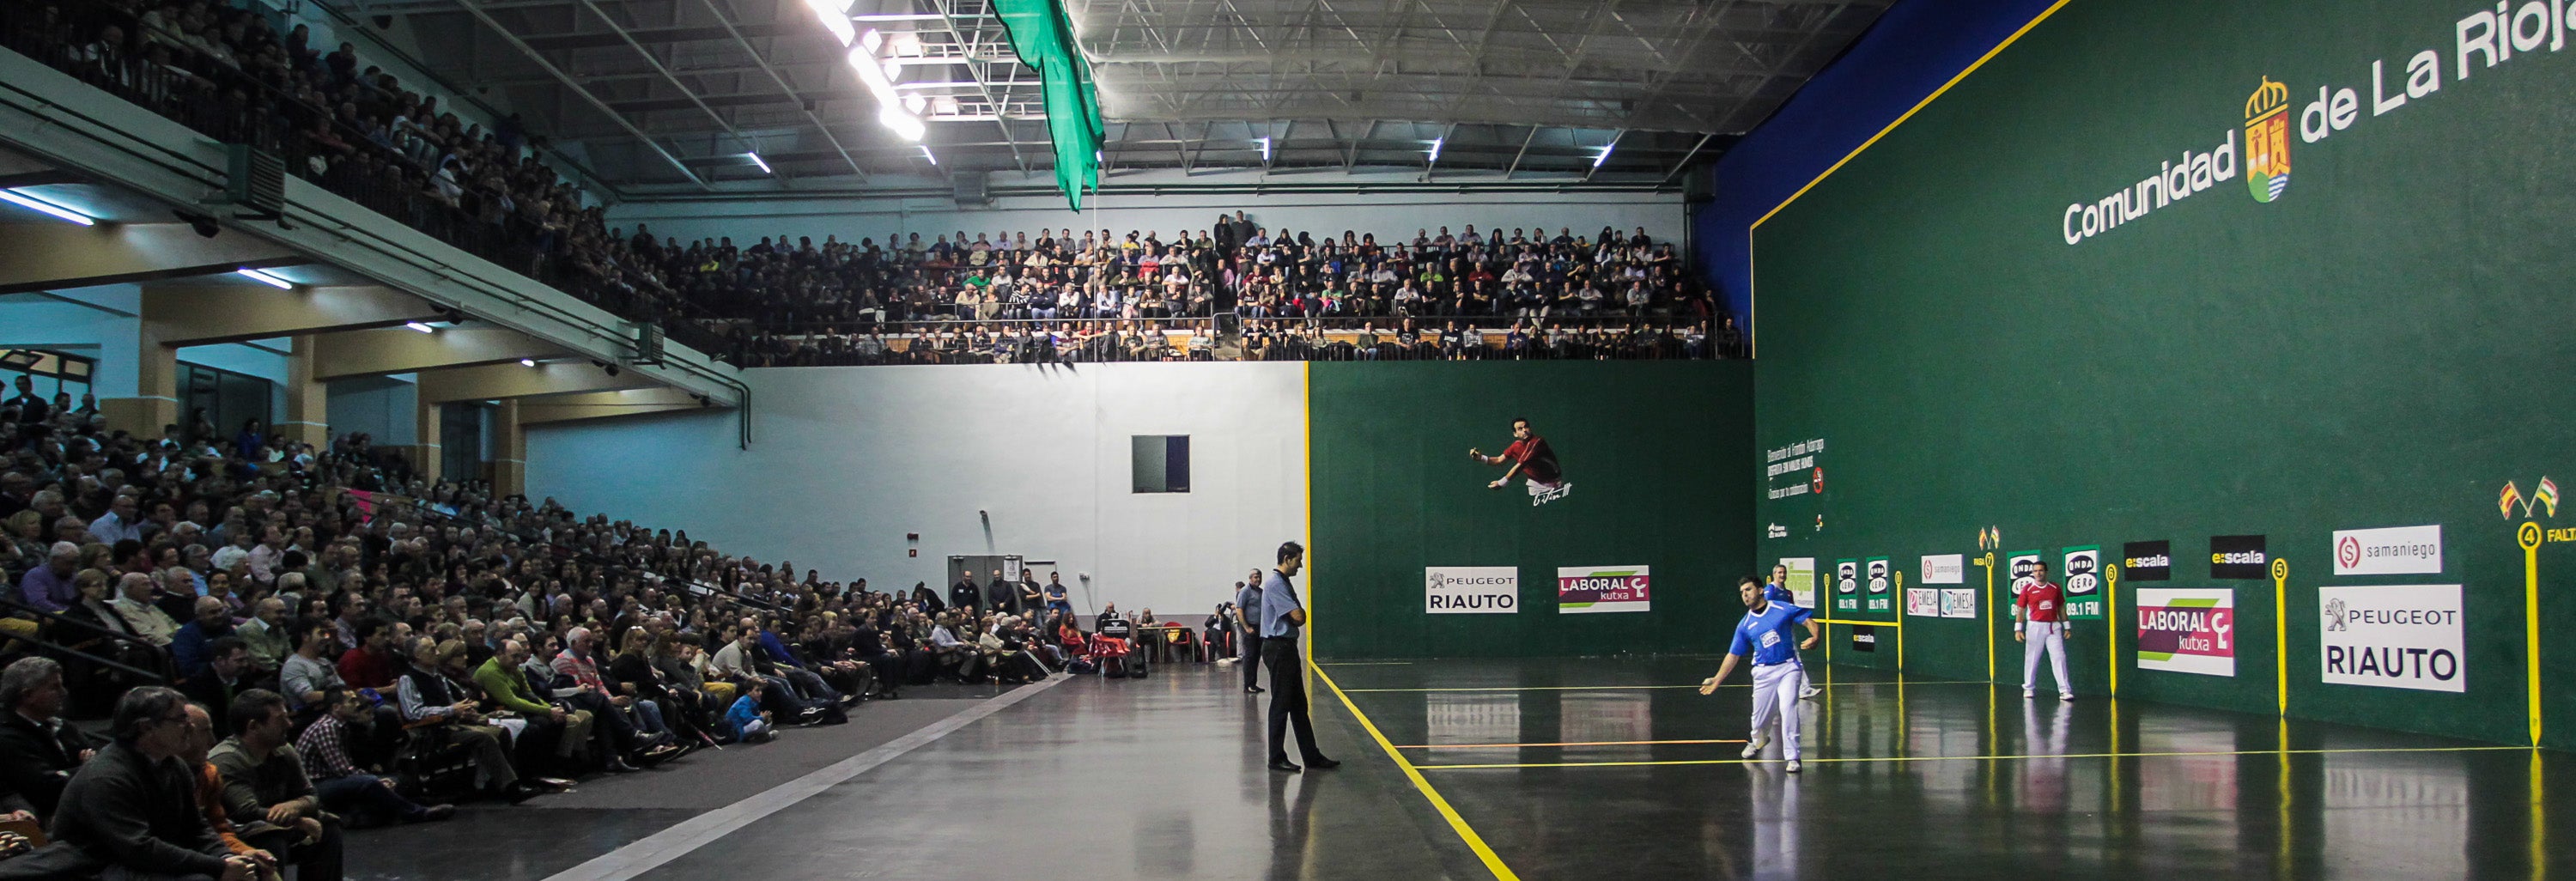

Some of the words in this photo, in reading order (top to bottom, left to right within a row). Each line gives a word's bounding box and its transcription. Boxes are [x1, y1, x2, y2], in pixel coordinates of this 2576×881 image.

[2063, 129, 2236, 246] Comunidad
[2300, 86, 2358, 143] de
[2372, 50, 2439, 117] La
[2524, 528, 2535, 544] 4
[2547, 527, 2576, 542] FALT
[2212, 550, 2264, 564] e:scala
[2366, 541, 2435, 559] samaniego
[2069, 560, 2093, 570] ONDA
[2125, 555, 2169, 568] e:scala
[2108, 568, 2115, 580] 6
[2275, 563, 2284, 576] 5
[1560, 578, 1628, 591] LABORAL
[2071, 578, 2093, 588] CERO
[1430, 594, 1514, 609] RIAUTO
[1601, 592, 1629, 600] kutxa
[1919, 591, 1936, 605] EMESA
[1953, 592, 1973, 609] EMESA
[2066, 603, 2083, 616] 89.1
[2085, 601, 2099, 615] FM
[2139, 611, 2209, 632] LABORAL
[2348, 610, 2457, 625] PEUGEOT
[2178, 635, 2209, 651] kutxa
[2326, 645, 2457, 681] RIAUTO
